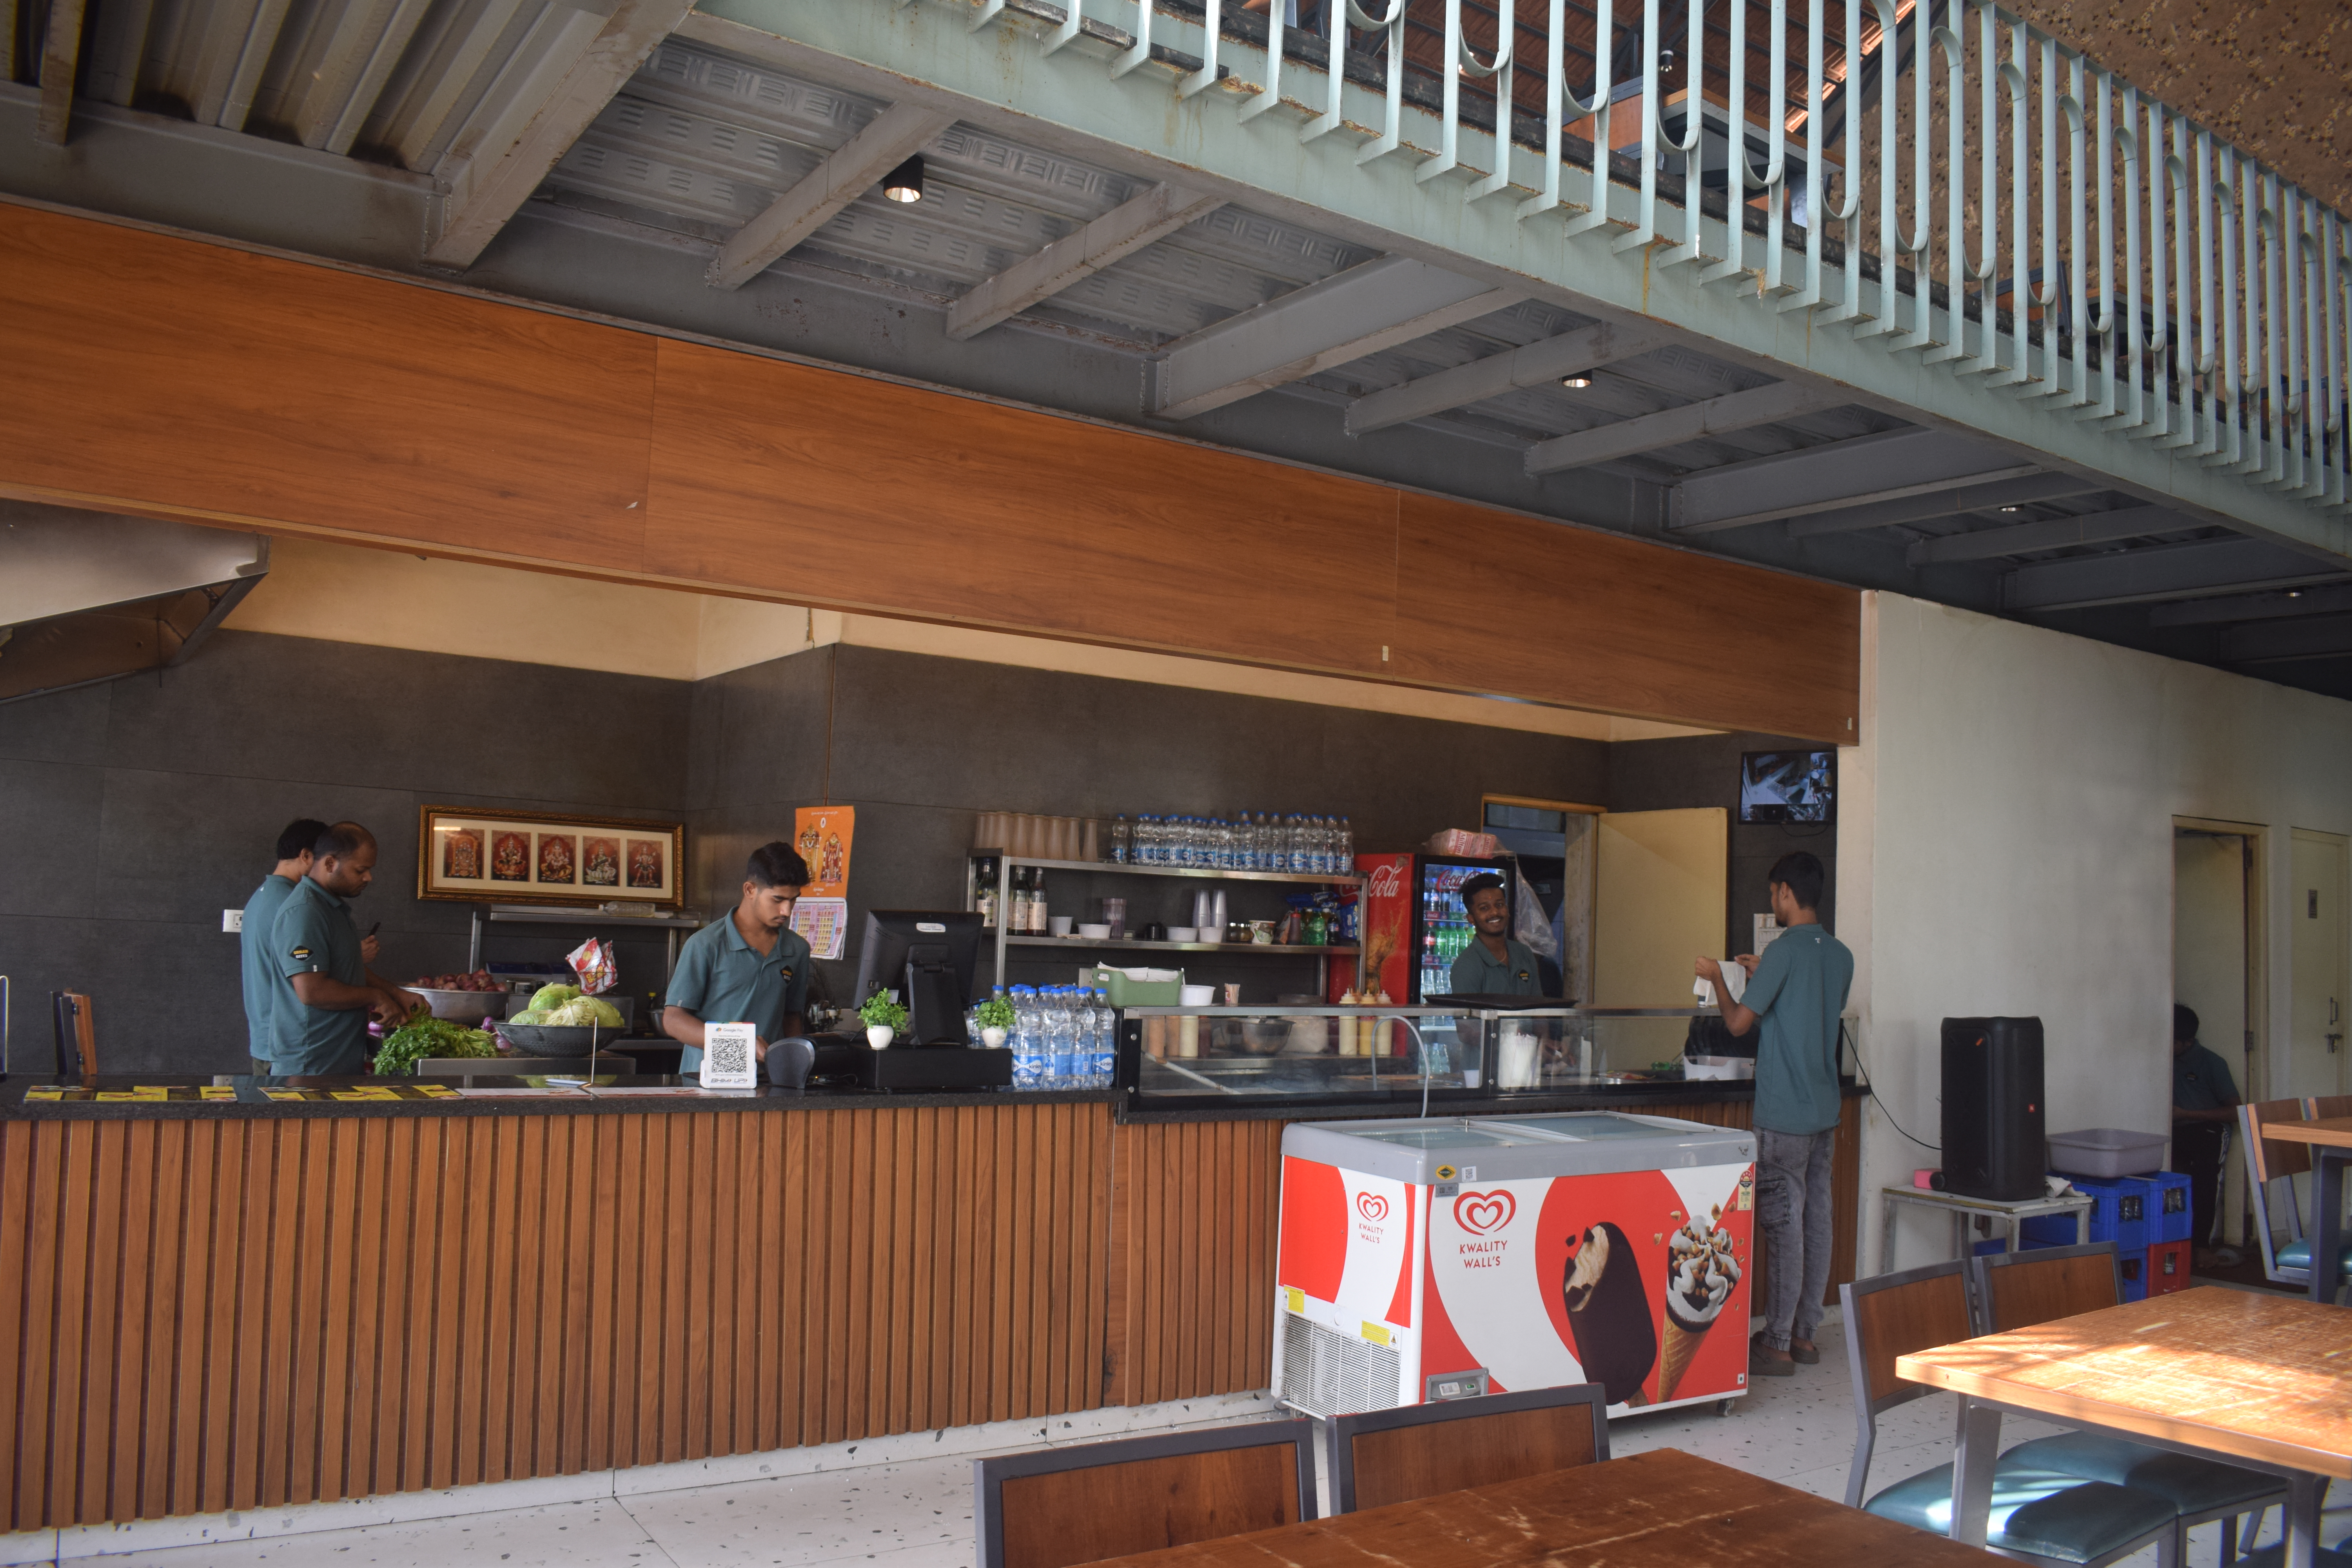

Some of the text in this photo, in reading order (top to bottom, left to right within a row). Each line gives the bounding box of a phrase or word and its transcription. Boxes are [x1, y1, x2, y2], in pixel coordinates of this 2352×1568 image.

[1456, 833, 1466, 853] Milton
[1359, 1222, 1384, 1235] KWALITY
[1361, 1232, 1380, 1243] WALL'S
[1460, 1240, 1508, 1254] KWALITY
[1464, 1256, 1501, 1269] WALL'S
